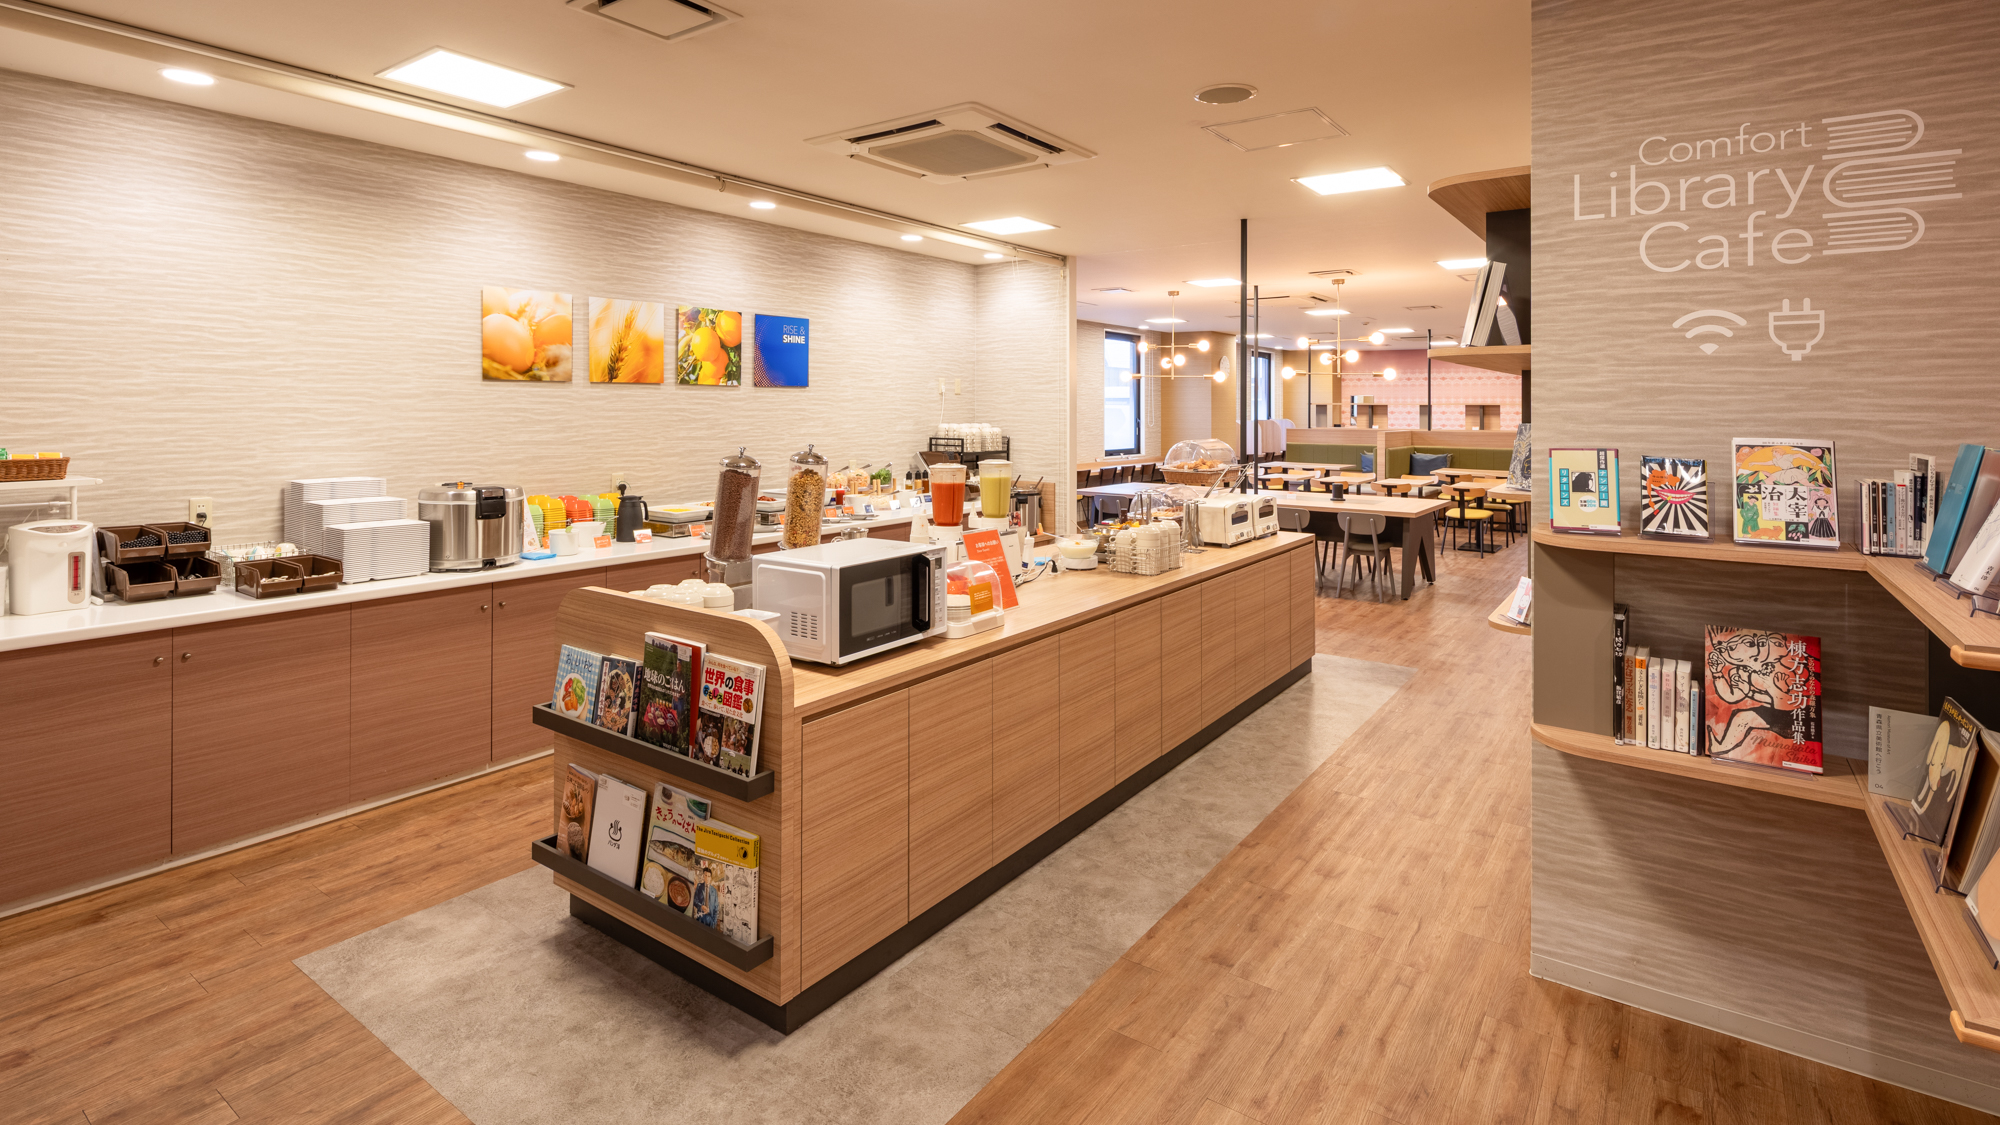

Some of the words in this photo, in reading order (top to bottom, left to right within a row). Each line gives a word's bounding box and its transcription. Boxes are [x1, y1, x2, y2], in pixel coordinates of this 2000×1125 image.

[1638, 122, 1813, 166] Comfort
[1573, 164, 1815, 220] Library
[1639, 210, 1814, 273] Cafe
[782, 334, 806, 344] SHINE
[783, 325, 798, 335] RISE
[800, 326, 806, 335] &
[1561, 470, 1569, 505] リターンズ
[1599, 470, 1608, 507] ナンシー関
[643, 667, 685, 693] 地球のごはん
[704, 667, 755, 696] 世界の食事
[1787, 640, 1808, 745] 棟方志功作品集
[703, 686, 743, 711] おもしろ図鑑
[1750, 735, 1818, 755] Munakata
[1785, 751, 1818, 765] Shiko
[655, 806, 696, 833] きょうのごはん
[712, 830, 730, 840] Taniguchi
[730, 835, 750, 845] Collection
